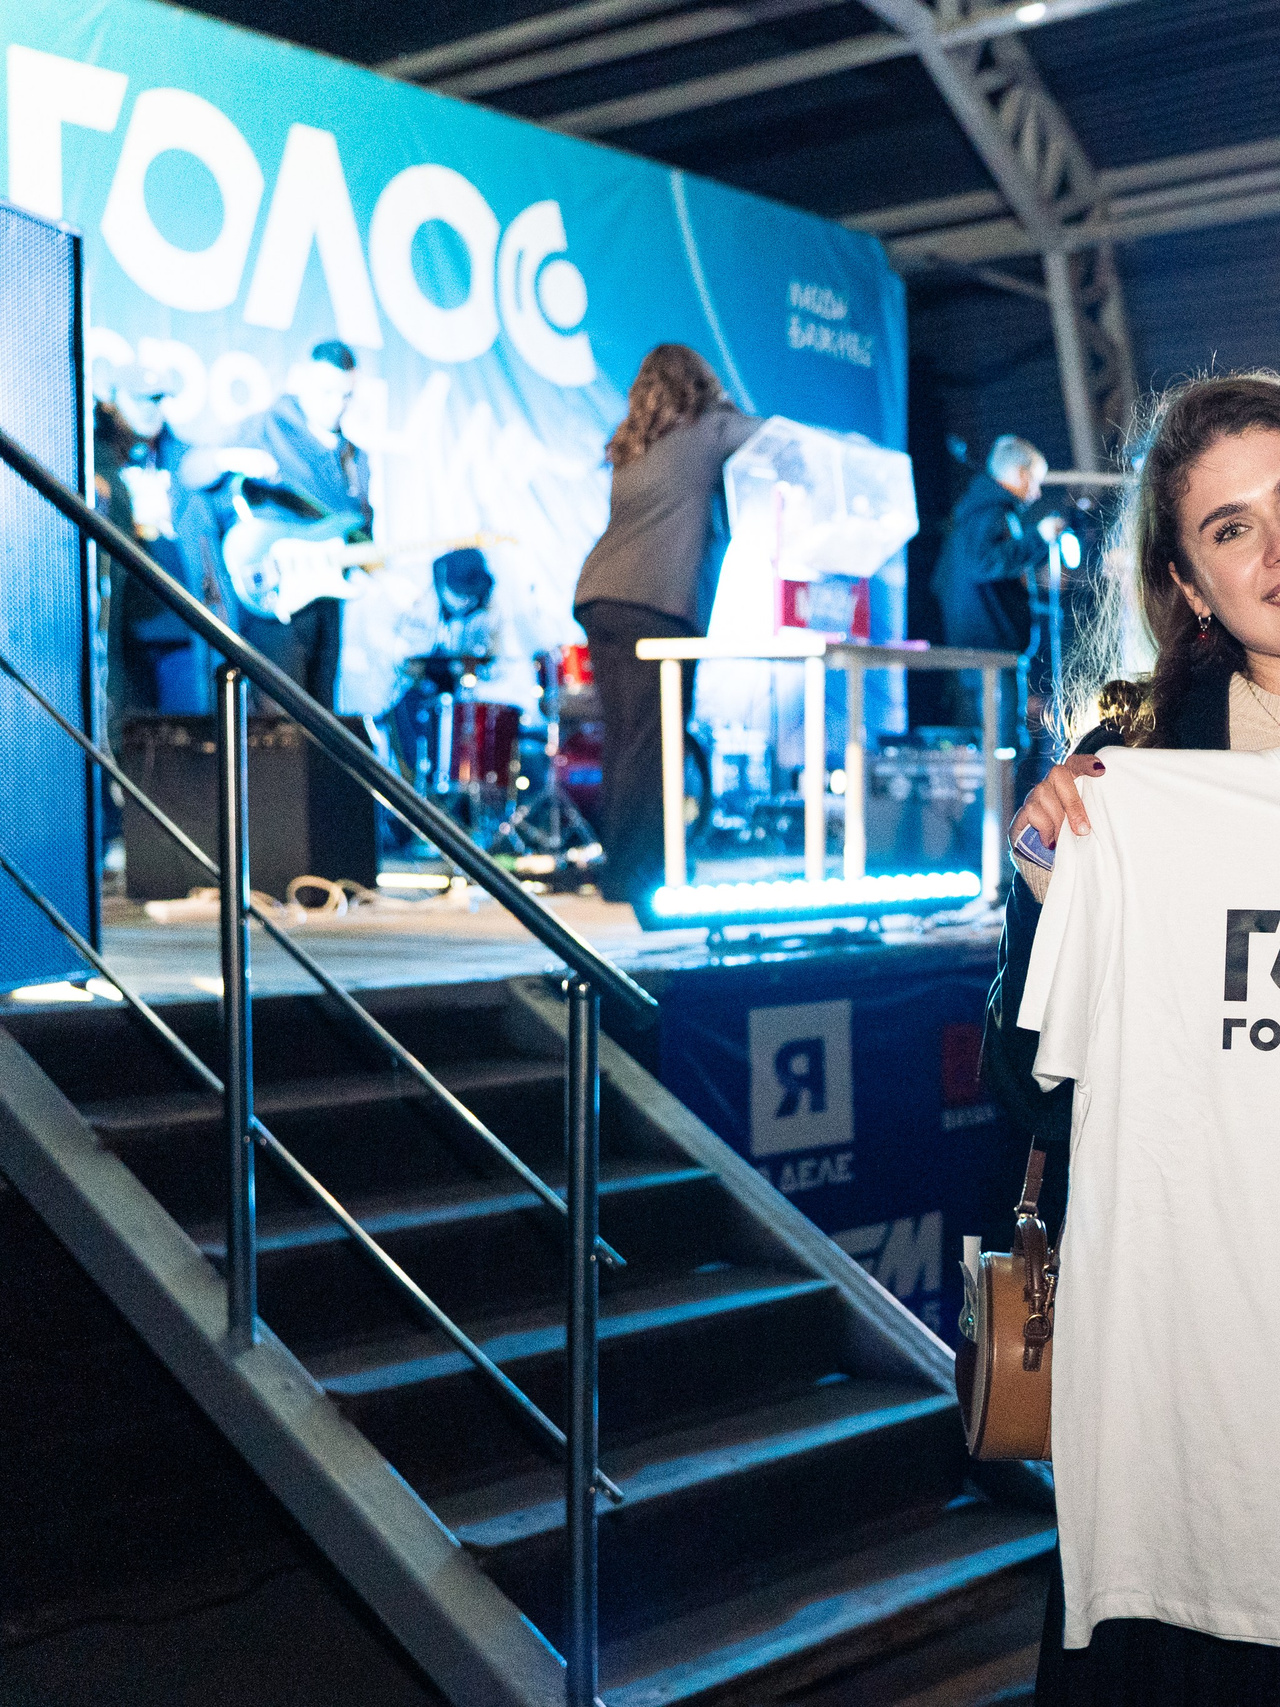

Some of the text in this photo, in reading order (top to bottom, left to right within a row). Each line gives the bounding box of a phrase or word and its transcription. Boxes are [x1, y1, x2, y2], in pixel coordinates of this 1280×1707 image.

[6, 44, 597, 387] ГОЛОС
[774, 1037, 826, 1119] Я
[779, 1151, 855, 1194] ДЕЛЕ
